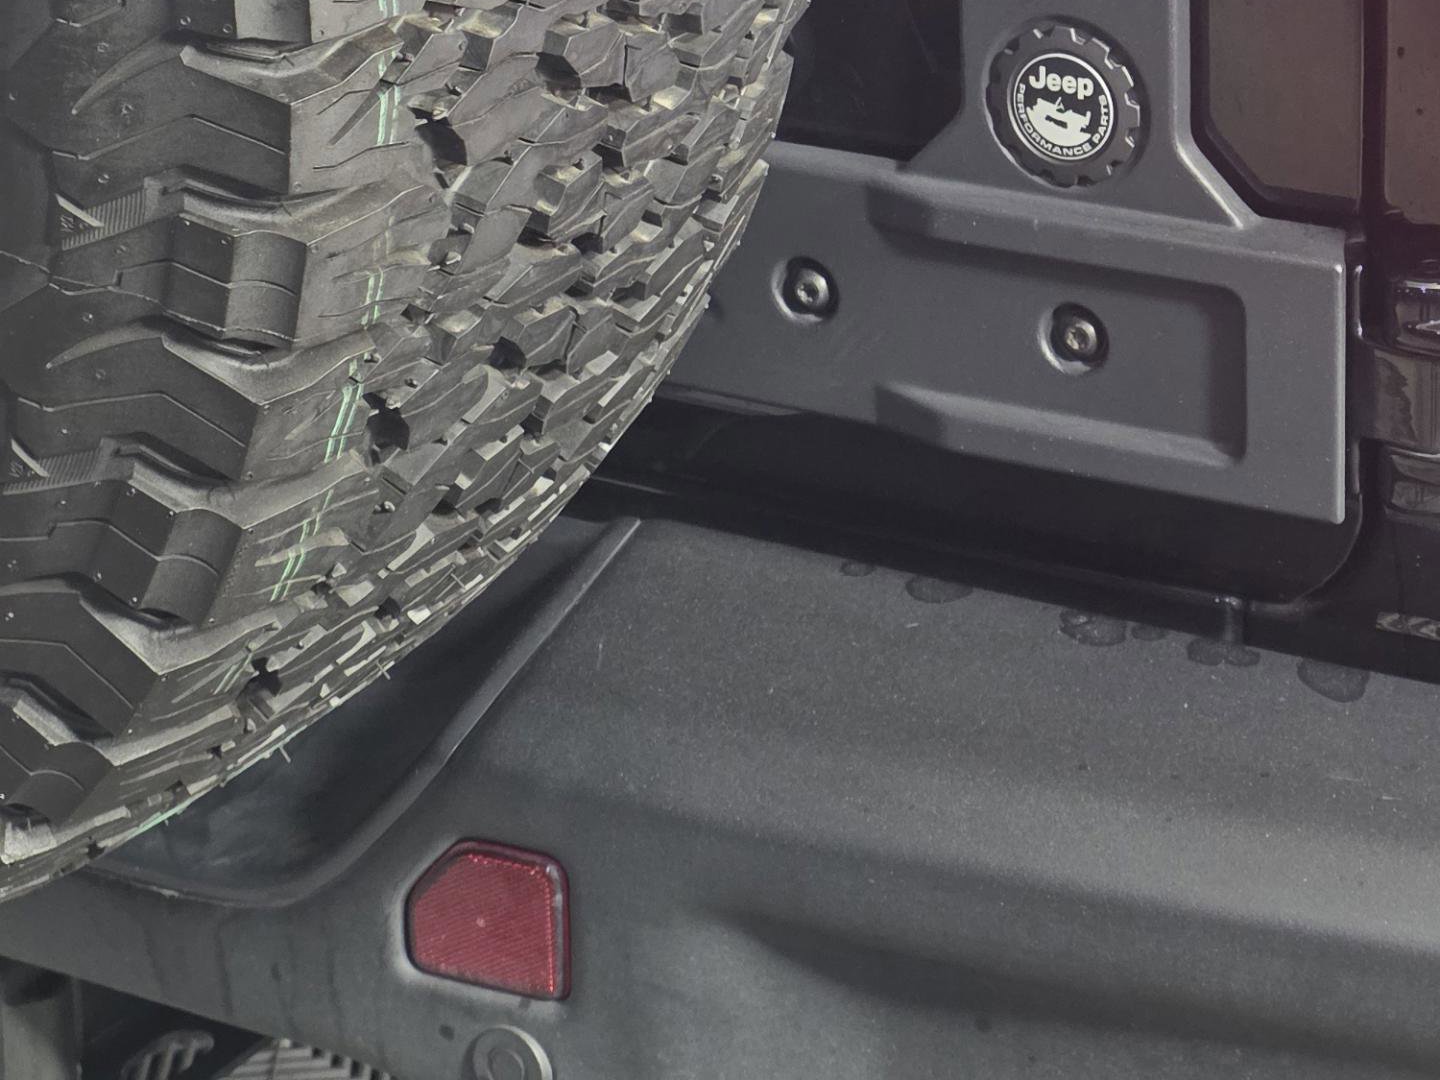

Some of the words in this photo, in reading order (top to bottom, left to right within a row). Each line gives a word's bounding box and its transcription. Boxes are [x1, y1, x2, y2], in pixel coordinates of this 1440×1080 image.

[1029, 65, 1094, 100] Jeep
[1016, 83, 1092, 156] PERFORMANCE
[1093, 94, 1110, 144] PARTS
